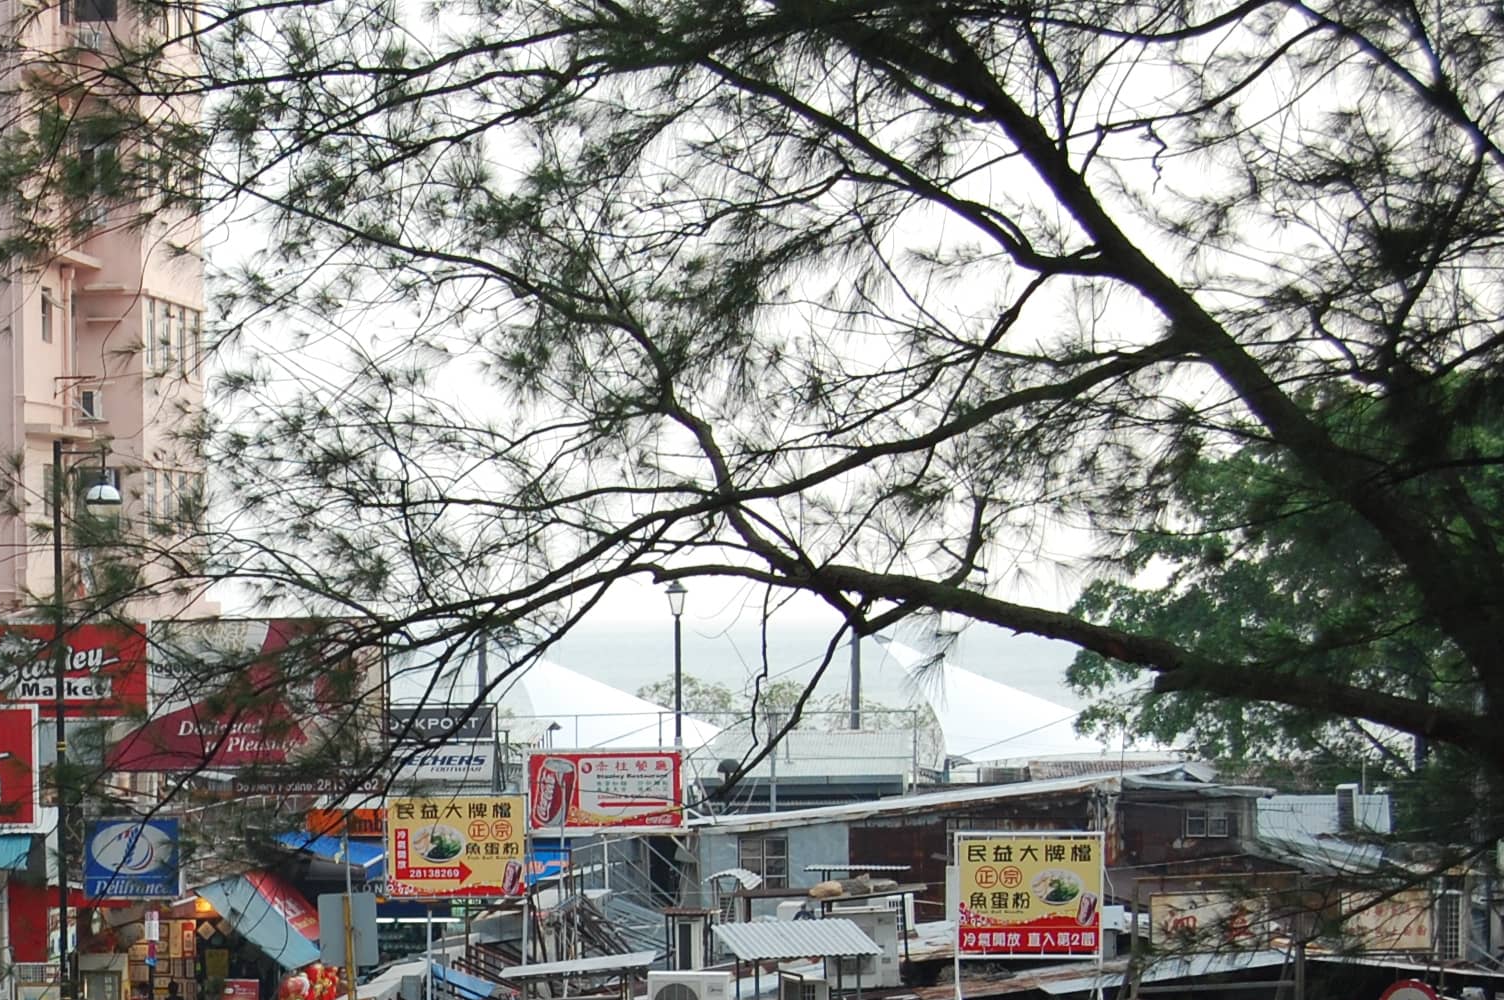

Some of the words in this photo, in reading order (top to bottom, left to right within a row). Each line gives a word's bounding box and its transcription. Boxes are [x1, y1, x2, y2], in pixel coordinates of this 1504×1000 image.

[22, 681, 106, 697] Maket
[396, 803, 511, 819] 民益大牌檔
[466, 843, 519, 856] 魚蛋粉
[967, 844, 1092, 863] 民益大牌檔
[410, 869, 460, 879] 28138269
[970, 891, 1031, 911] 魚蛋粉
